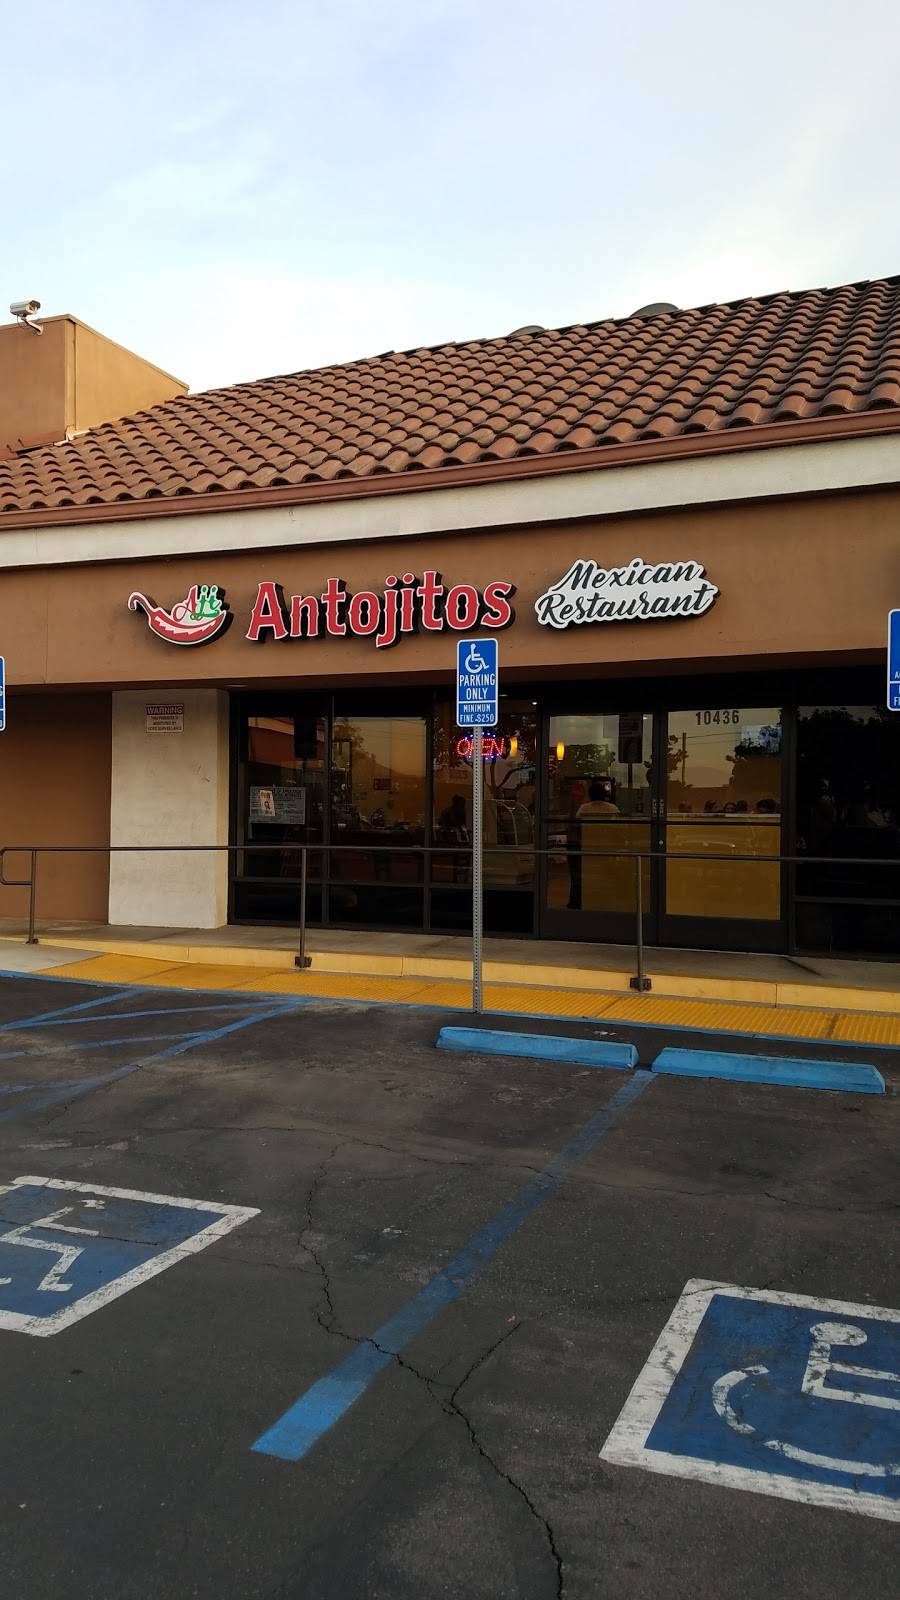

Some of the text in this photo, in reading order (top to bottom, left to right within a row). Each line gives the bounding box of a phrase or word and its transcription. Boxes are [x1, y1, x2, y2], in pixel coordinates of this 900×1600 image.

[552, 561, 701, 591] Mexican
[246, 571, 512, 648] Antojitos
[537, 583, 715, 625] Restaurant
[459, 674, 496, 687] PARKING
[466, 687, 488, 700] ONLY
[147, 706, 183, 714] WARNING
[463, 704, 491, 713] MINIMUM
[695, 710, 740, 726] 10436
